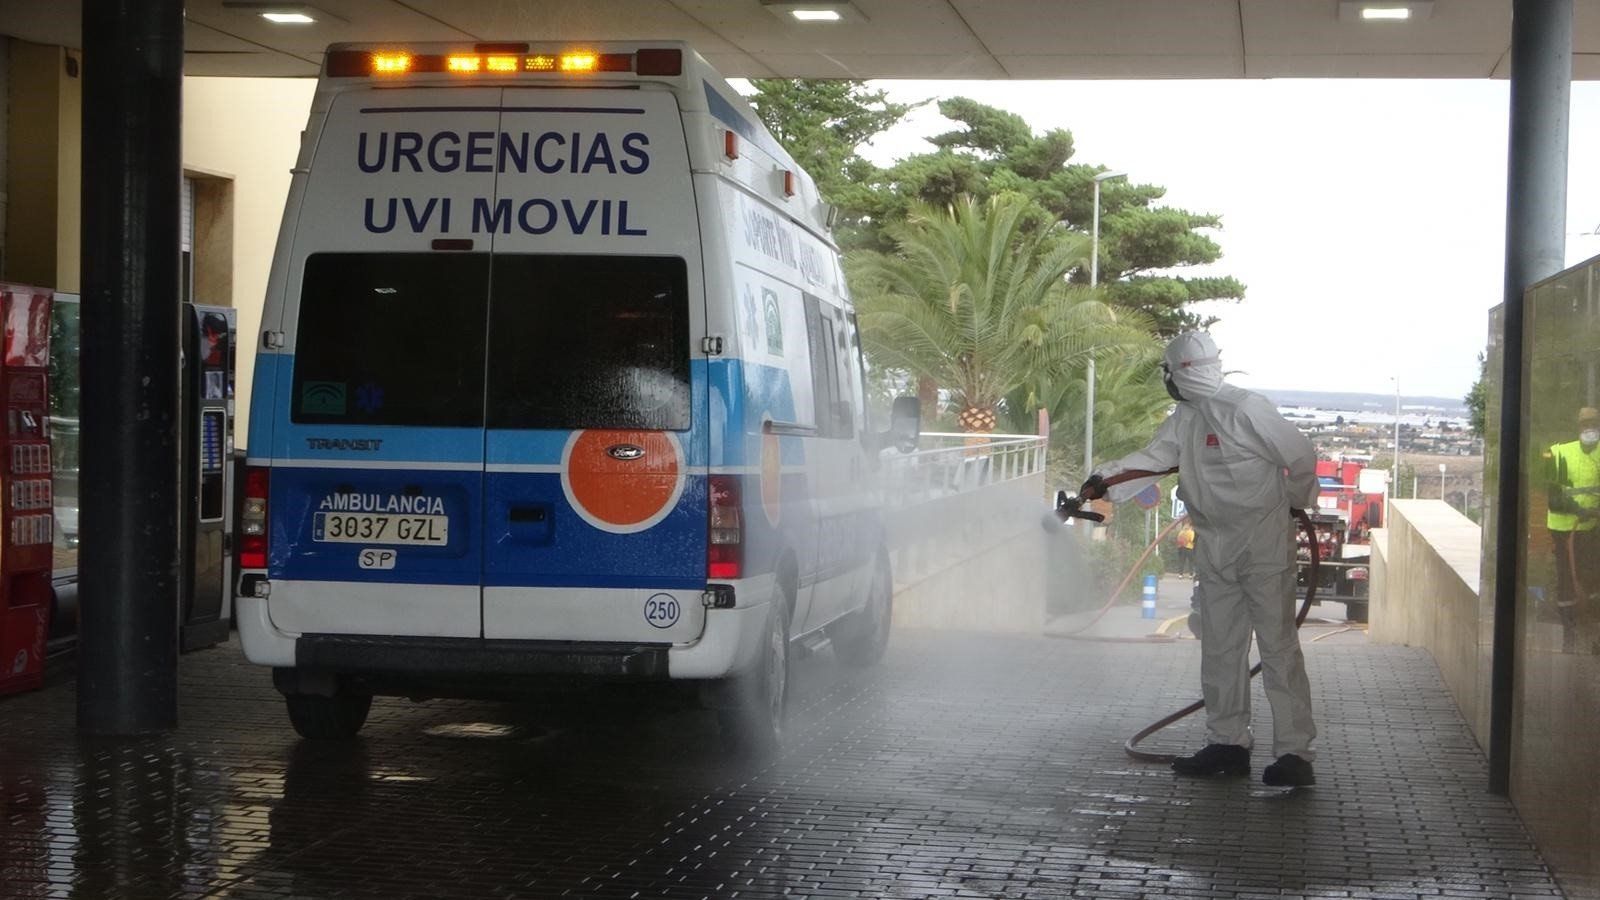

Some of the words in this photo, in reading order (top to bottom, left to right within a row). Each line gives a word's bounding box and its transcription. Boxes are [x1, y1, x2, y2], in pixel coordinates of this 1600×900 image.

[358, 131, 650, 174] URGENCIAS
[364, 198, 451, 233] UVI
[472, 198, 648, 236] MOVIL
[320, 493, 445, 514] AMBULANCIA
[329, 516, 389, 539] 3037
[397, 519, 441, 541] GZL
[649, 601, 676, 620] 250
